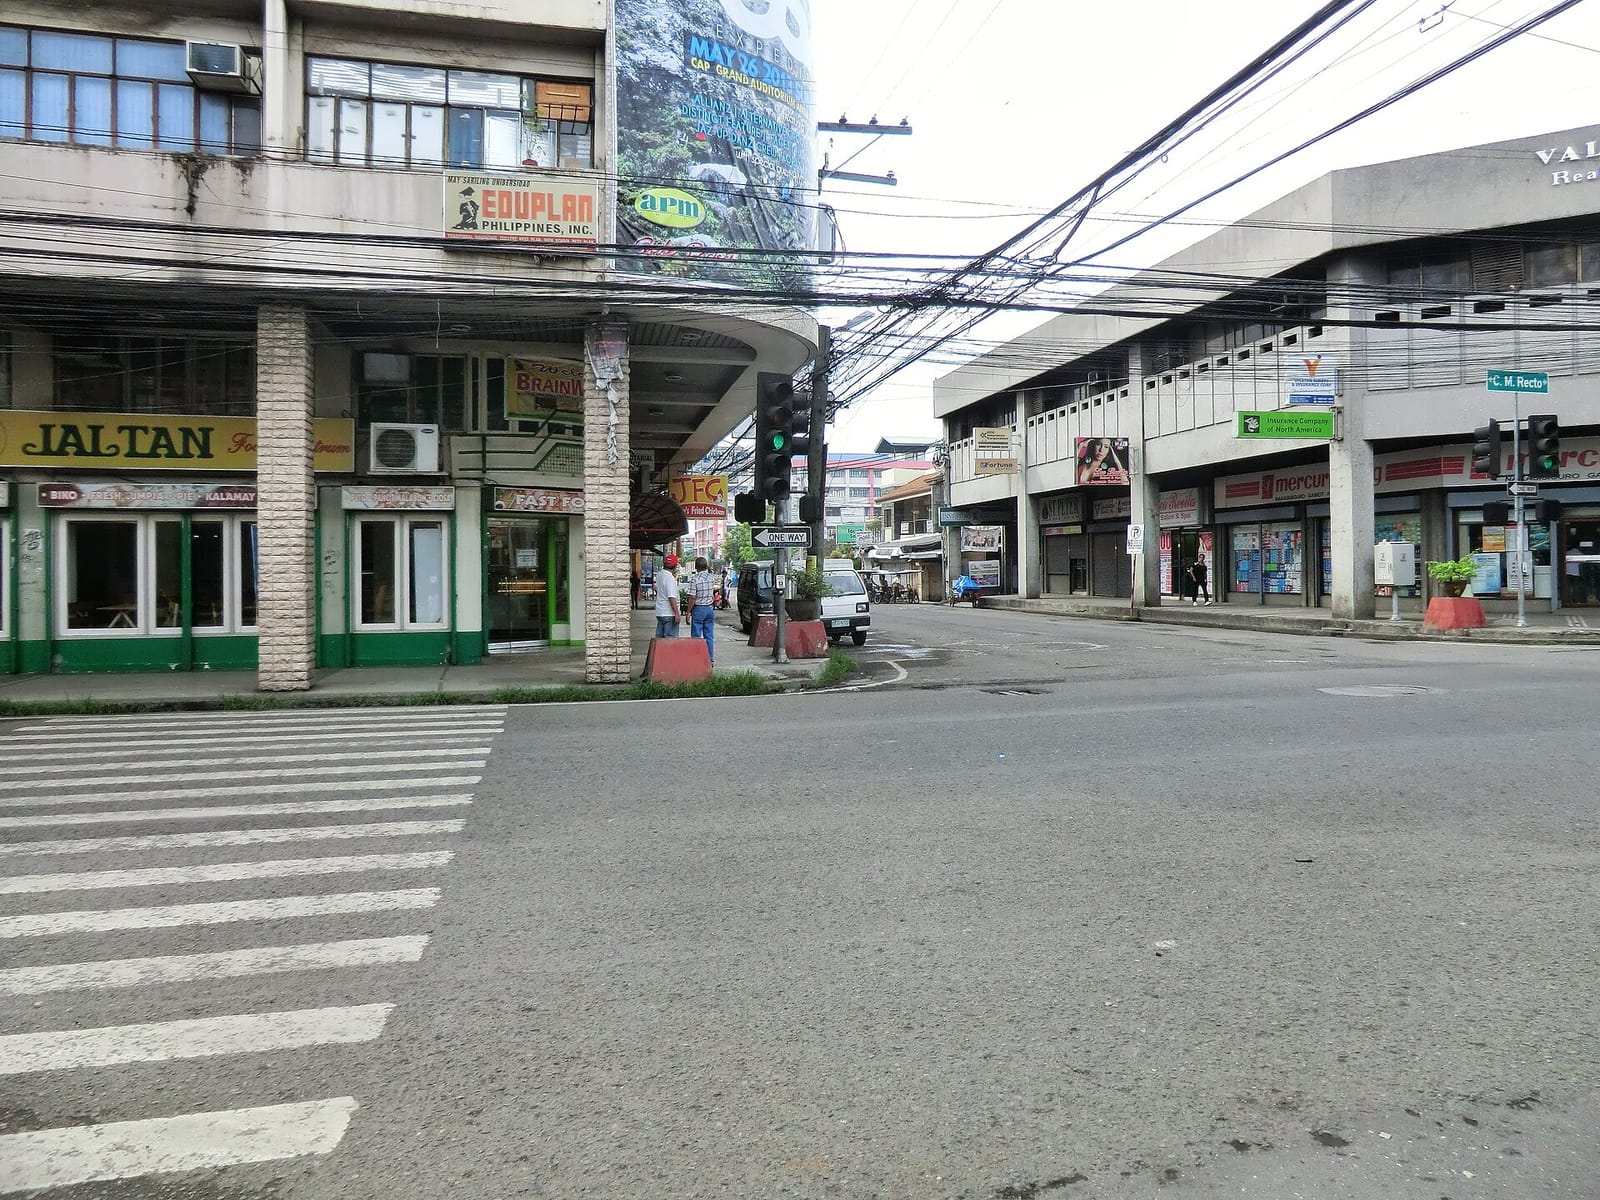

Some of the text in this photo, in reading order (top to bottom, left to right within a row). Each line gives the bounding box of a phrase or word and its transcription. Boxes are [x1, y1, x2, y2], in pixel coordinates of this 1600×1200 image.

[690, 36, 737, 67] MAY
[739, 51, 760, 78] 26
[690, 56, 711, 72] CAP
[715, 63, 749, 85] GRAND
[682, 104, 723, 125] DISTINCT
[695, 122, 712, 137] JAZ
[447, 175, 460, 184] MAY
[463, 176, 490, 186] SARILING
[1551, 170, 1600, 186] Rea
[482, 189, 593, 223] EDUPLAN
[482, 220, 593, 235] PHILIPPINES, INC.
[1493, 375, 1543, 388] C. M. Recto
[1300, 417, 1329, 426] Company
[51, 490, 78, 500] BIKO
[90, 491, 121, 500] FRESH
[177, 492, 193, 501] PIE
[205, 492, 256, 501] KALAMAY
[671, 477, 721, 502] JFC
[516, 494, 586, 509] FAST FO
[691, 507, 704, 515] Fried
[705, 507, 725, 515] Chicken
[769, 533, 805, 542] ONE WAY
